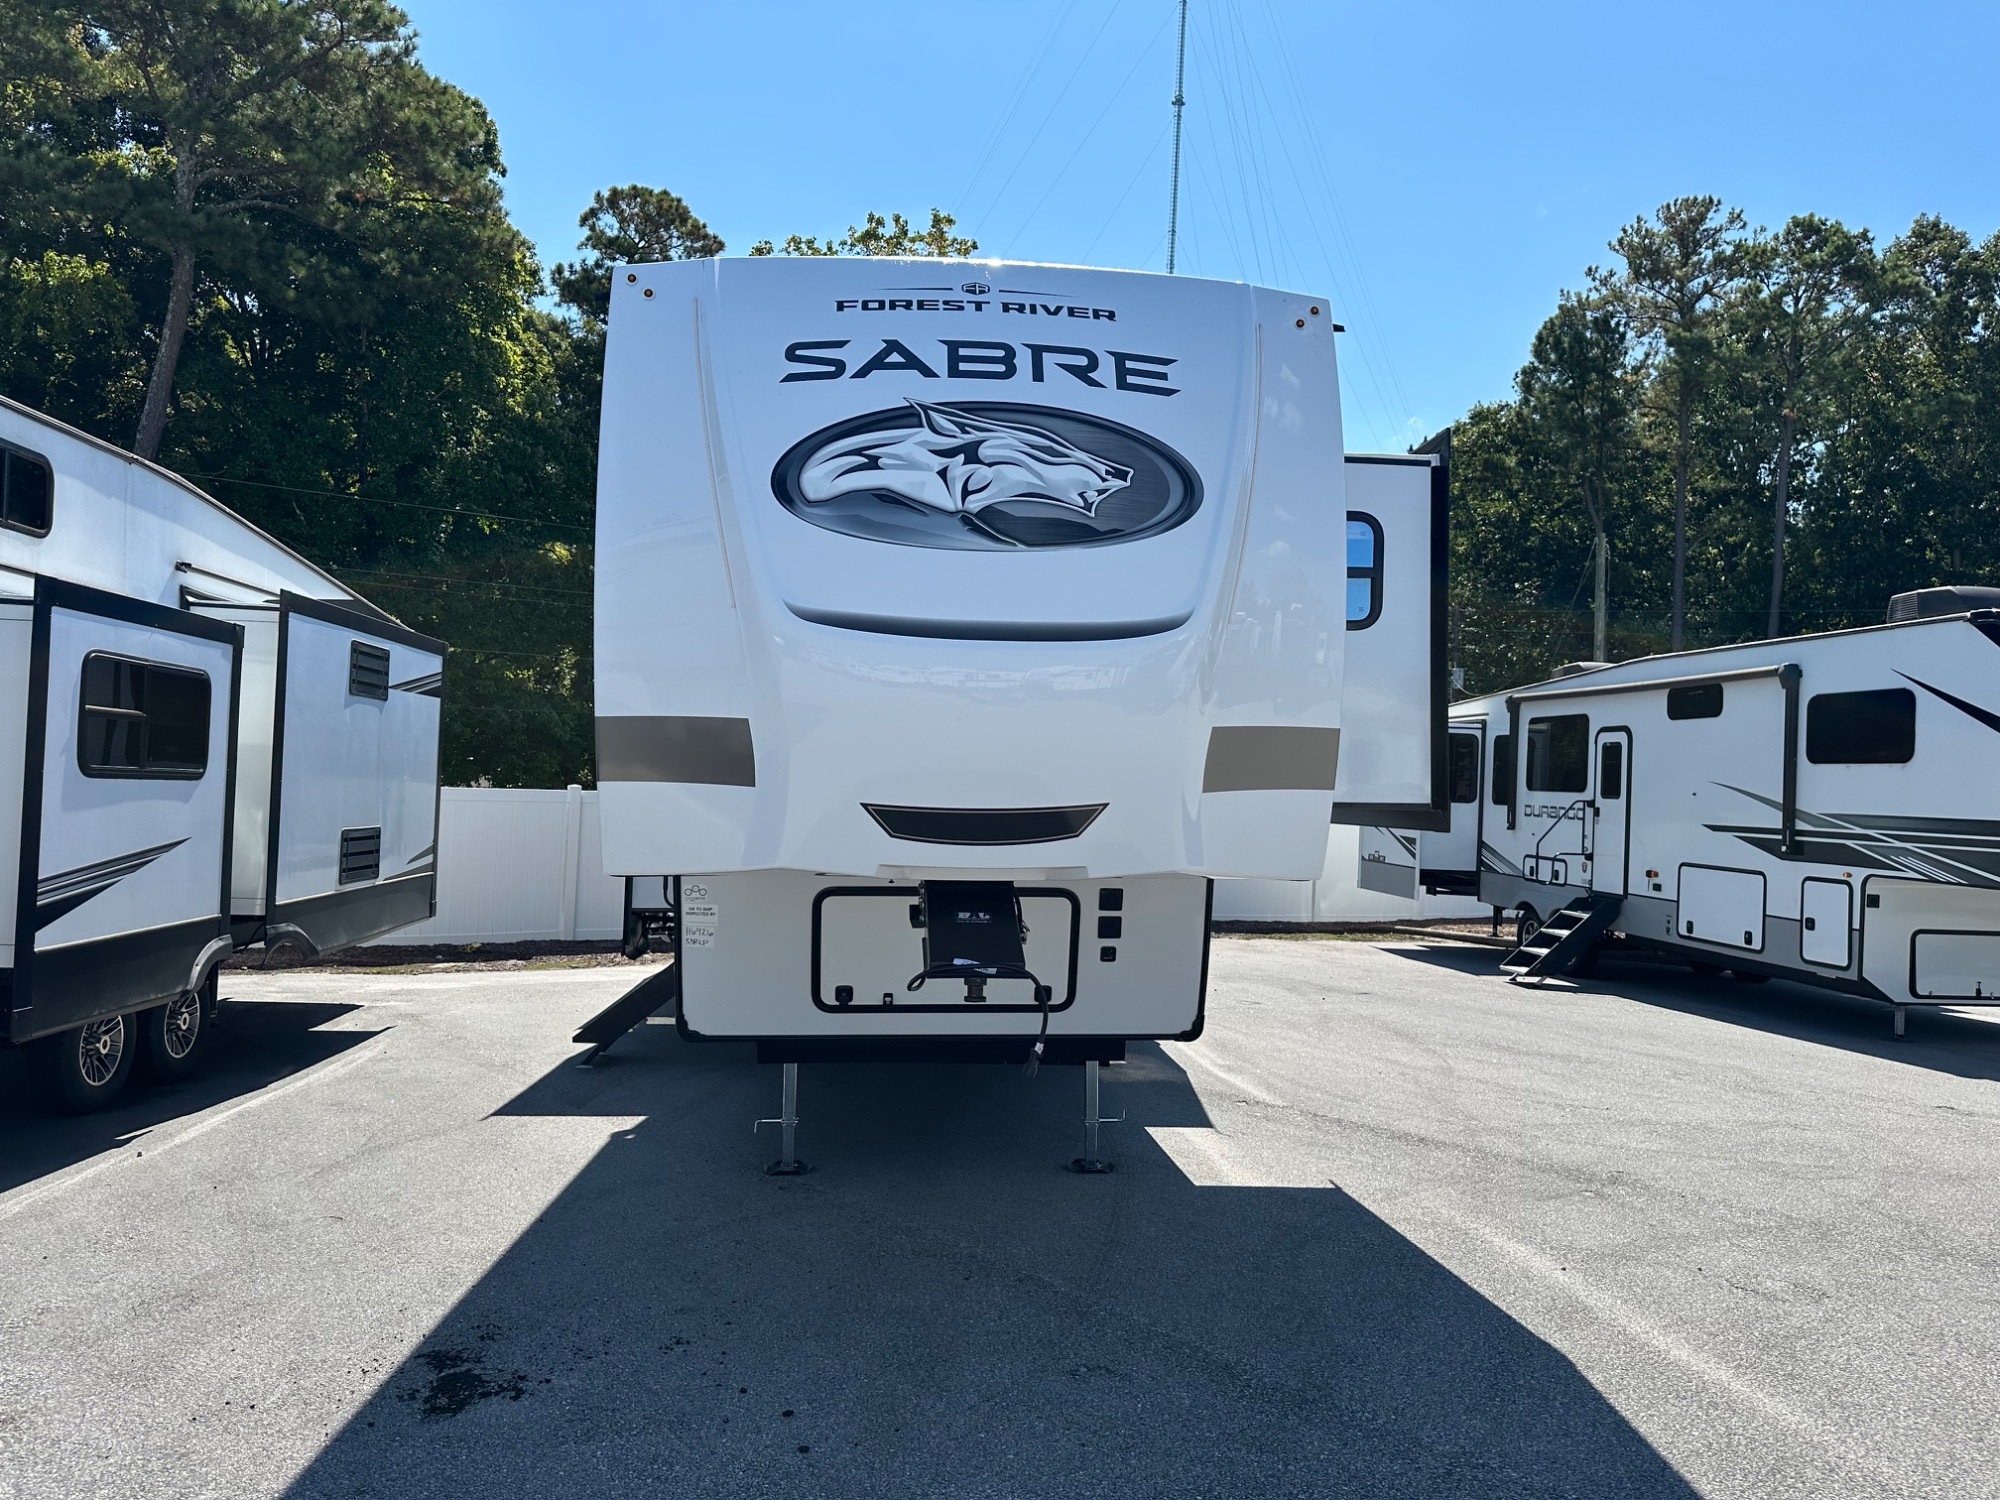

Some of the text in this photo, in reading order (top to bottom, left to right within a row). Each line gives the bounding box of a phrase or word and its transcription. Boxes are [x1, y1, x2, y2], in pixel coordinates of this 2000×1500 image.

[835, 299, 1118, 322] FOREST RIVER
[779, 338, 1182, 397] SABRE
